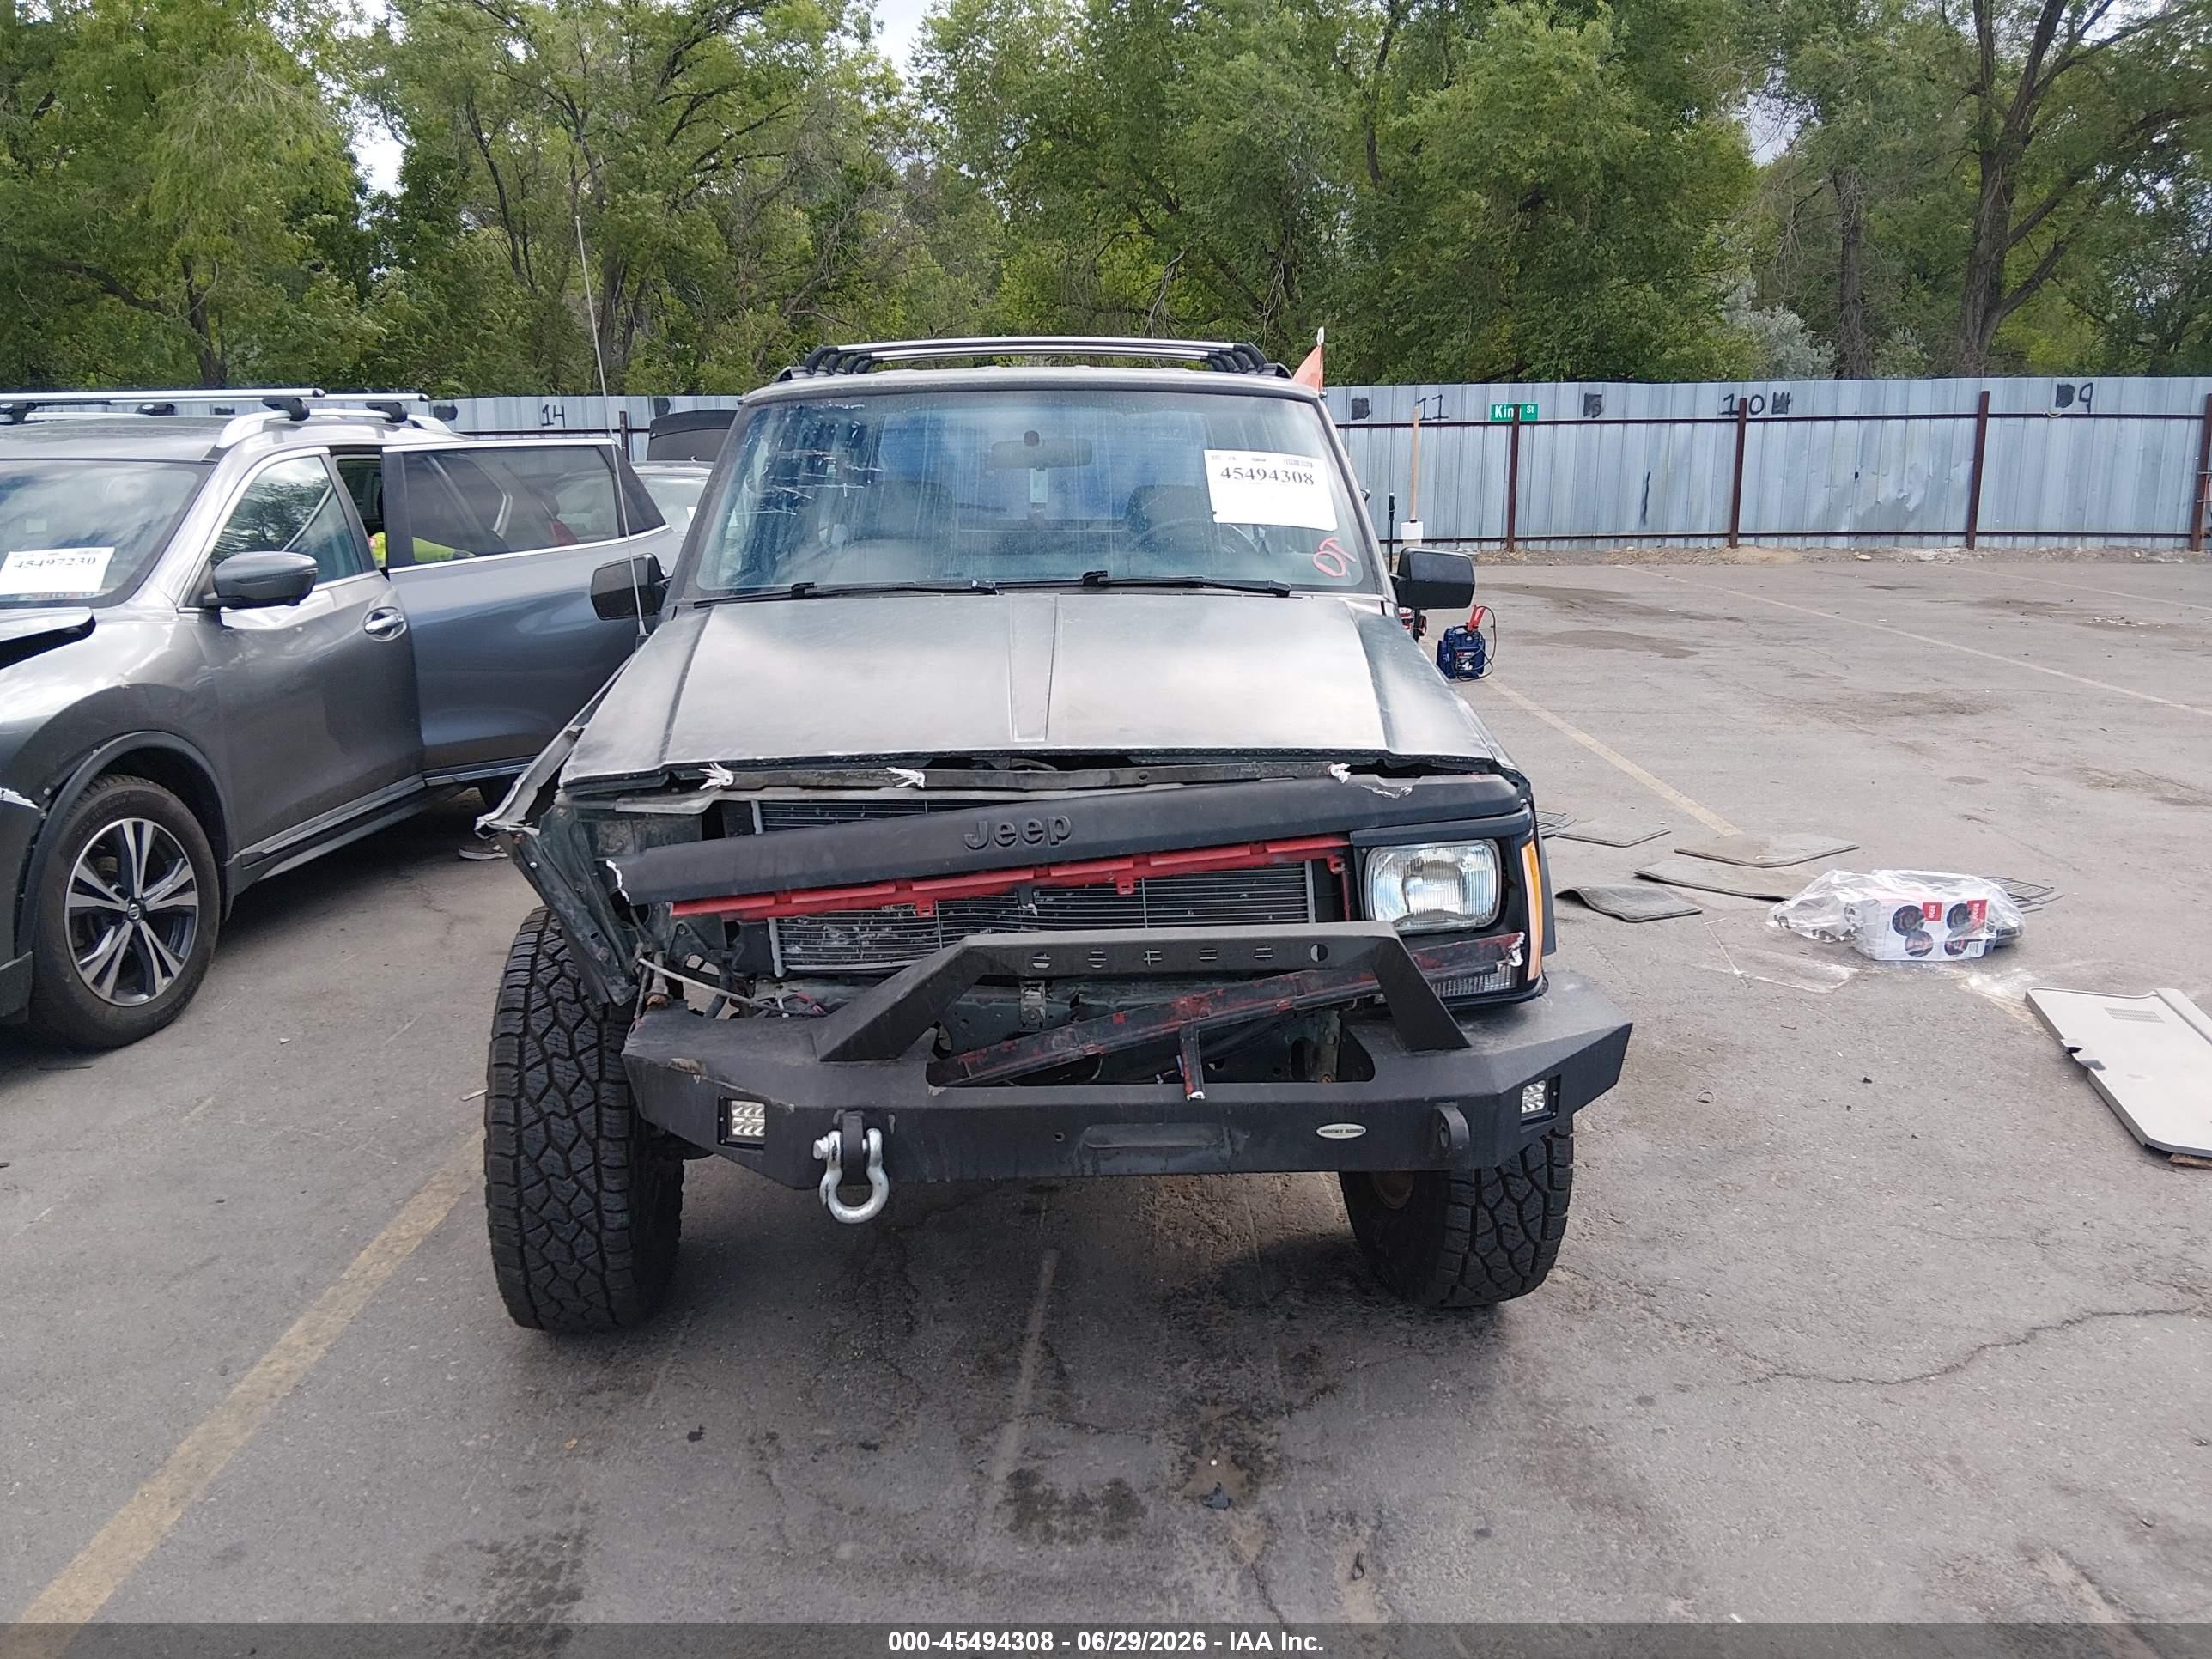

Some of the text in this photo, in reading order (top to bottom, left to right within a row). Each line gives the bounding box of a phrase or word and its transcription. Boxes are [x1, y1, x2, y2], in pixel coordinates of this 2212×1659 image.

[541, 404, 566, 428] 14
[1417, 394, 1449, 421] 11
[1494, 404, 1534, 420] Kin St
[1220, 466, 1315, 486] 45494308
[963, 816, 1073, 851] Jeep
